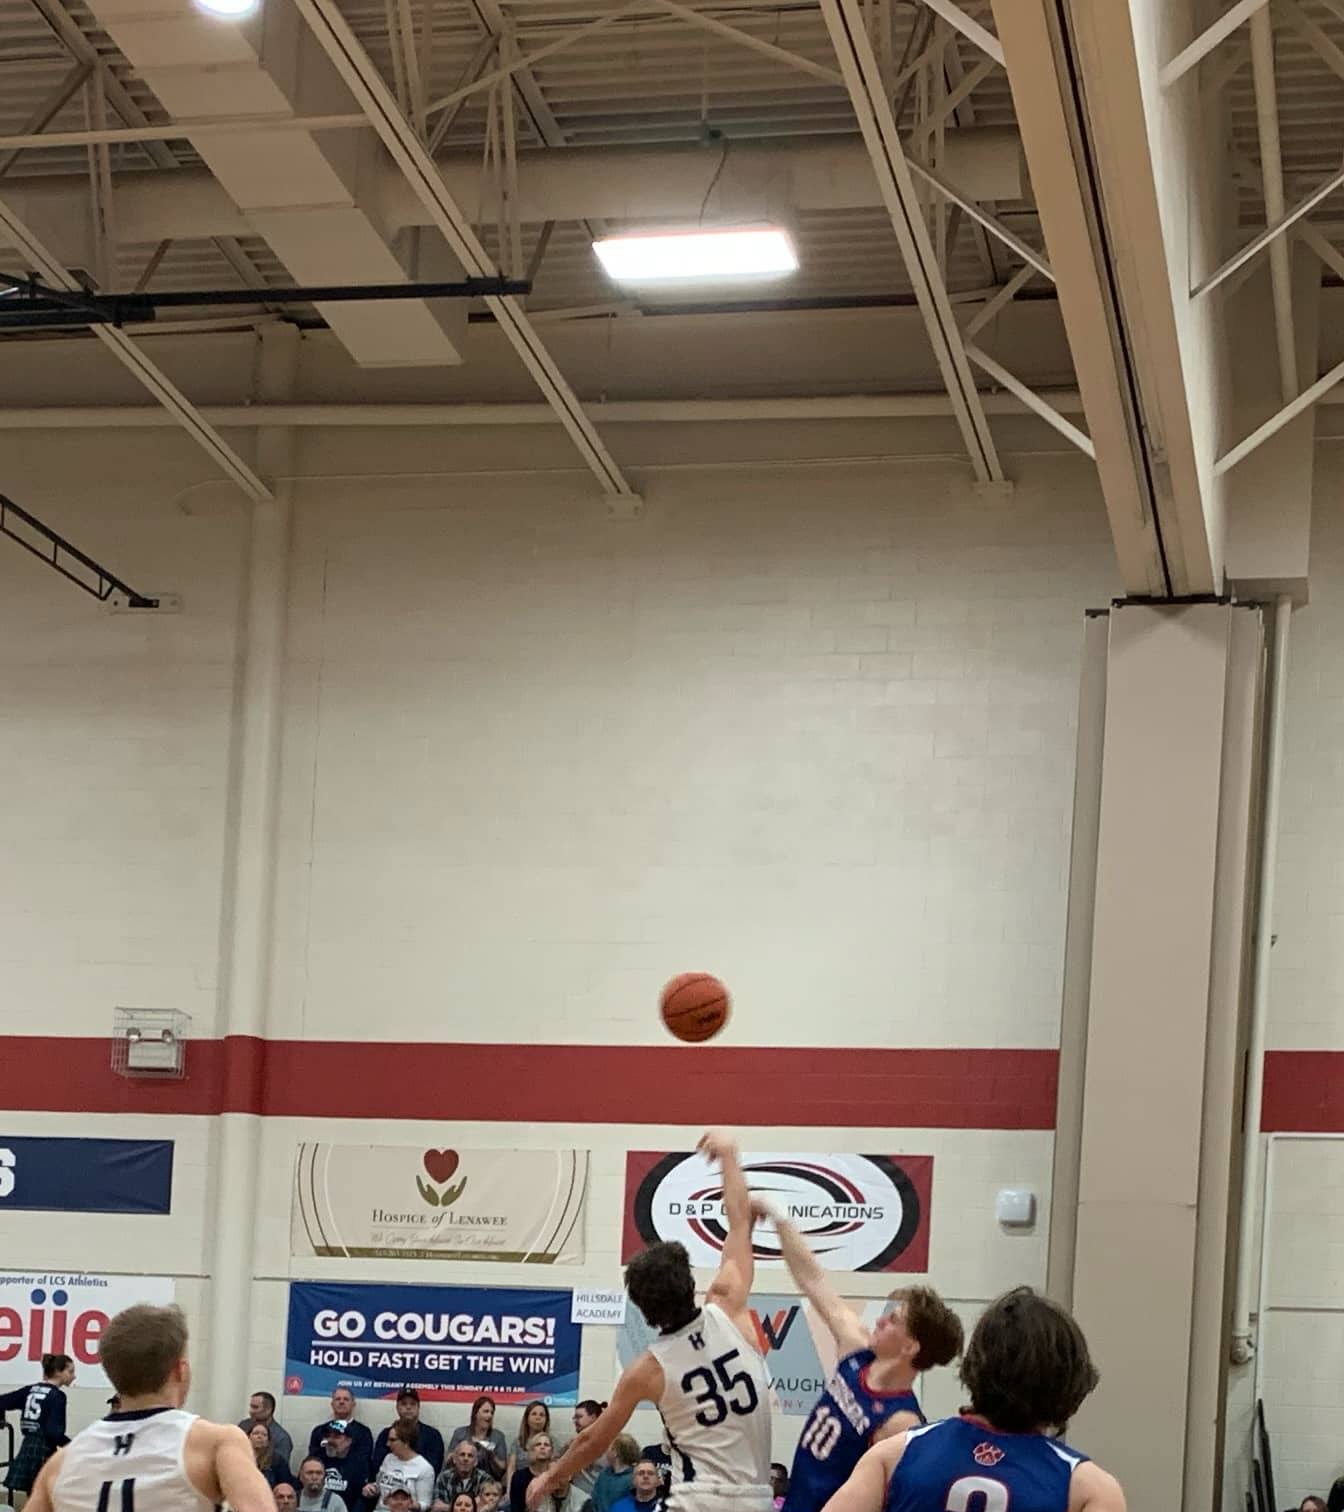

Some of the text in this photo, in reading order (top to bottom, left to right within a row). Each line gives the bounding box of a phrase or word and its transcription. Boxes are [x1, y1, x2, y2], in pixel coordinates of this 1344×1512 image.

[669, 1203, 712, 1215] D & P
[432, 1212, 447, 1228] of
[38, 1276, 46, 1285] of
[50, 1276, 66, 1285] LCS
[68, 1276, 108, 1287] Athletics
[577, 1295, 623, 1303] HILLSDALE
[576, 1309, 621, 1319] ACADEMY
[314, 1310, 555, 1345] GO COUGARS!
[310, 1350, 554, 1374] HOLD FAST! GET THE WIN!
[681, 1349, 758, 1427] 35
[24, 1393, 41, 1420] 15
[802, 1406, 841, 1460] 10
